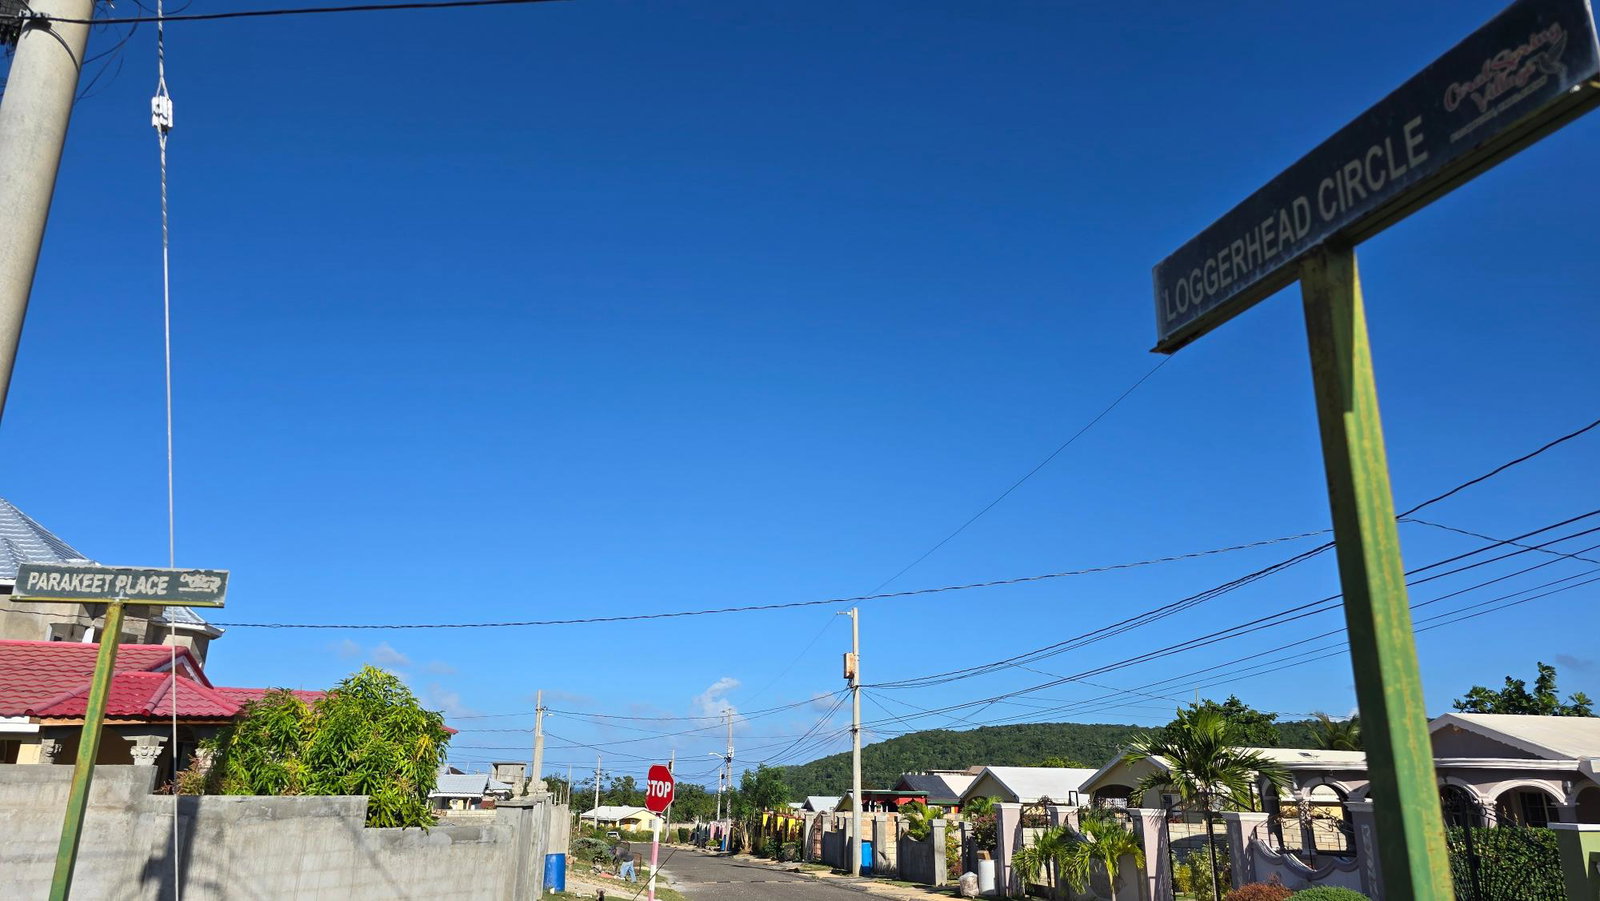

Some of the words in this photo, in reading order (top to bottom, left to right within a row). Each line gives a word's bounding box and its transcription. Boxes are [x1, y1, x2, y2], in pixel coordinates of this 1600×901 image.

[1163, 196, 1311, 322] LOGGERHEAD
[1317, 117, 1430, 222] CIRCLE
[27, 572, 114, 593] PARAKEET
[115, 574, 169, 596] PLACE
[646, 780, 672, 798] STOP
